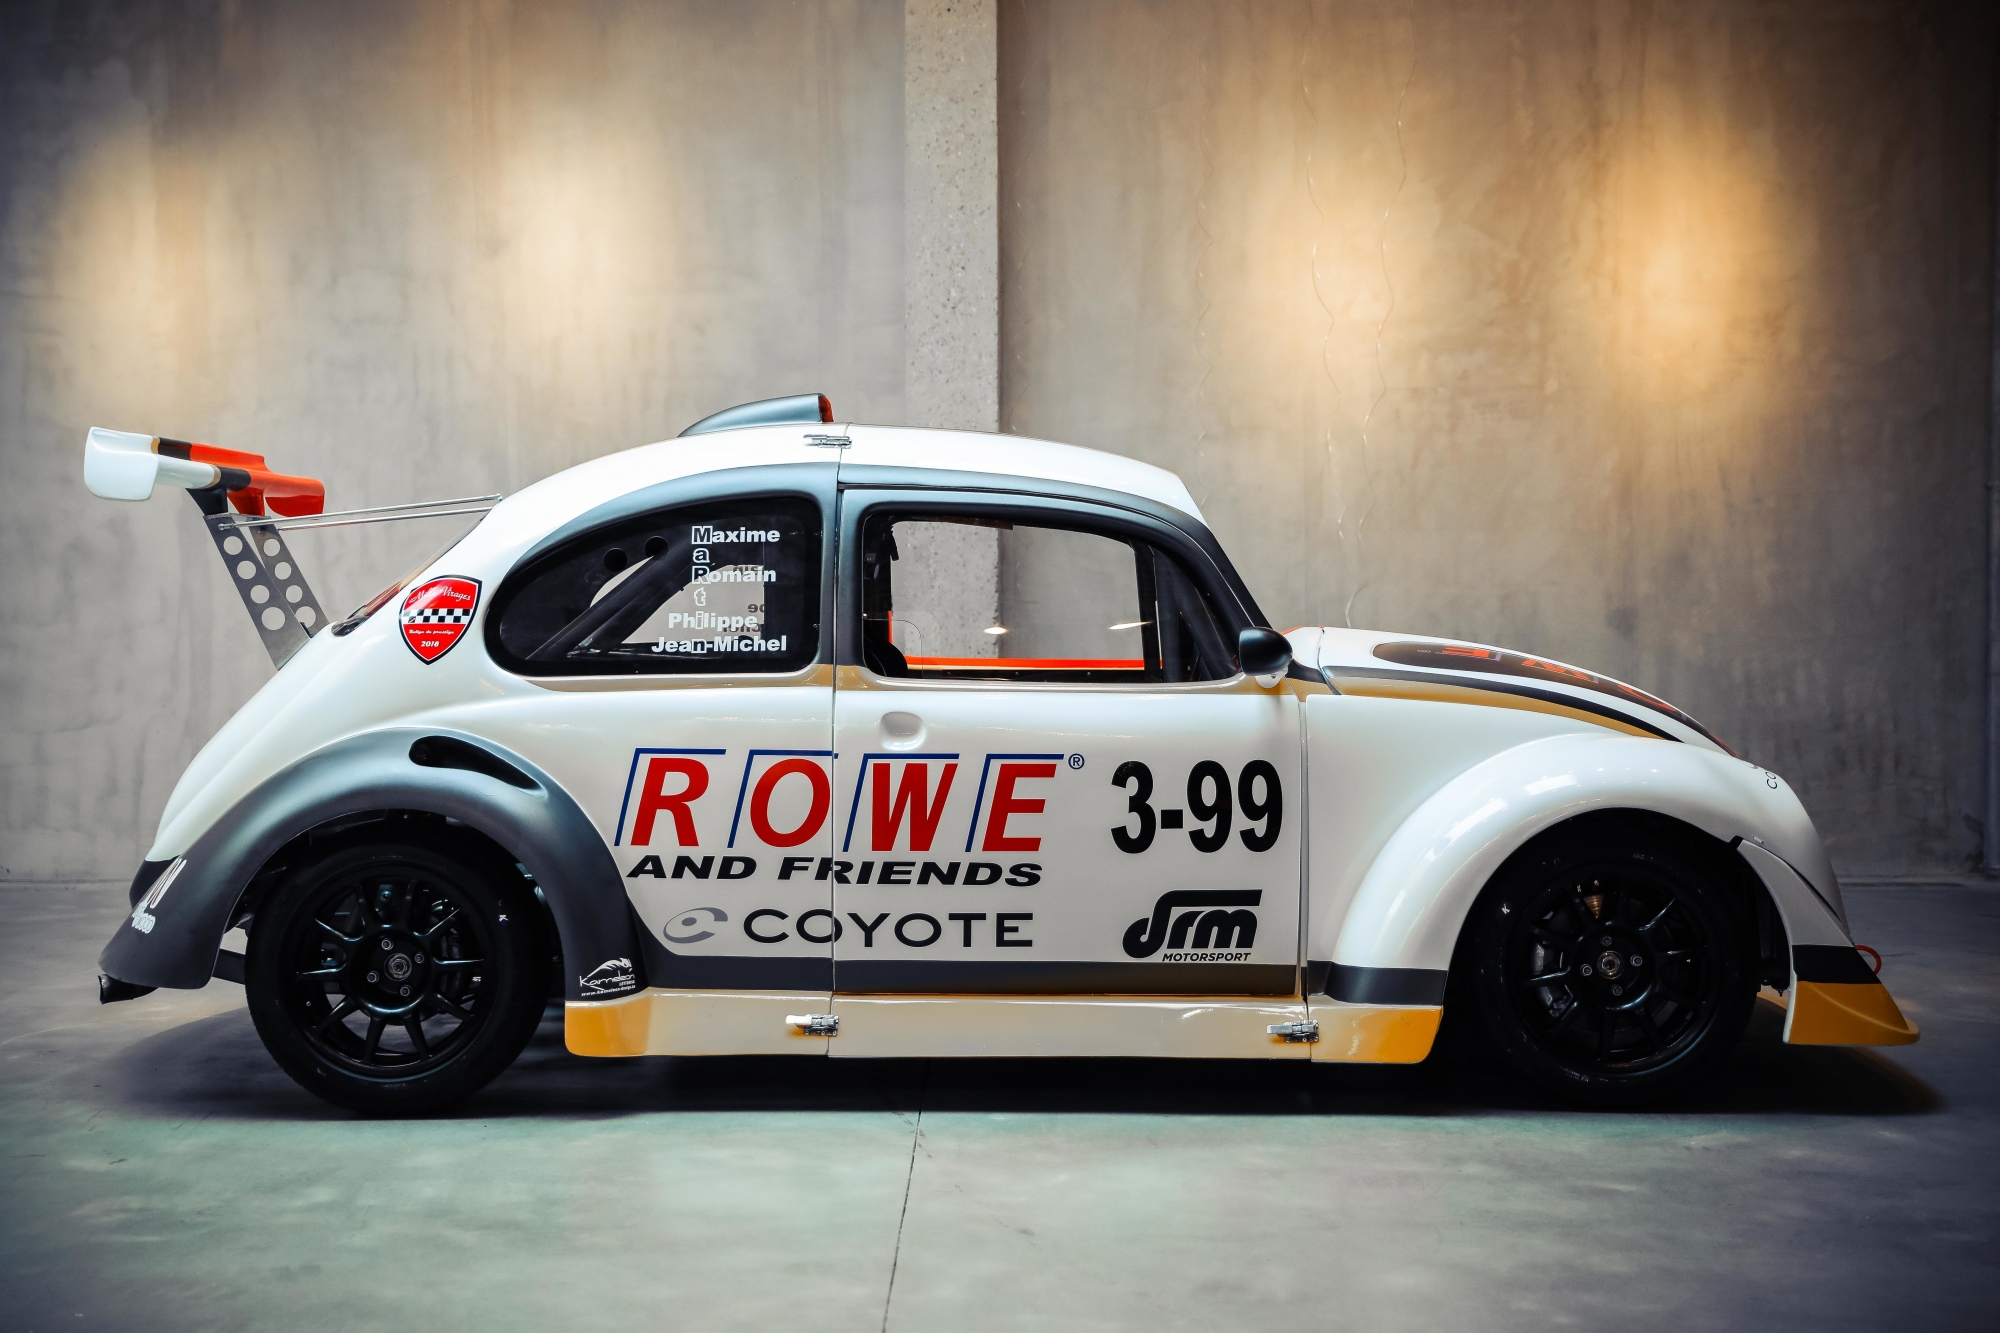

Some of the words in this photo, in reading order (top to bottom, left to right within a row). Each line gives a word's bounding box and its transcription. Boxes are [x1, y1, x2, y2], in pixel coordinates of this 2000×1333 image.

[691, 526, 780, 544] Maxime
[691, 565, 776, 584] Romain
[668, 610, 758, 632] Philippe
[420, 640, 440, 648] 2018
[651, 635, 787, 654] Jean-Michel
[630, 757, 1058, 852] ROWE
[1110, 759, 1283, 854] 3-99
[626, 854, 758, 879] AND
[777, 856, 1043, 887] FRIENDS
[743, 908, 1034, 948] COYOTE
[1162, 952, 1252, 962] MOTORSPORT
